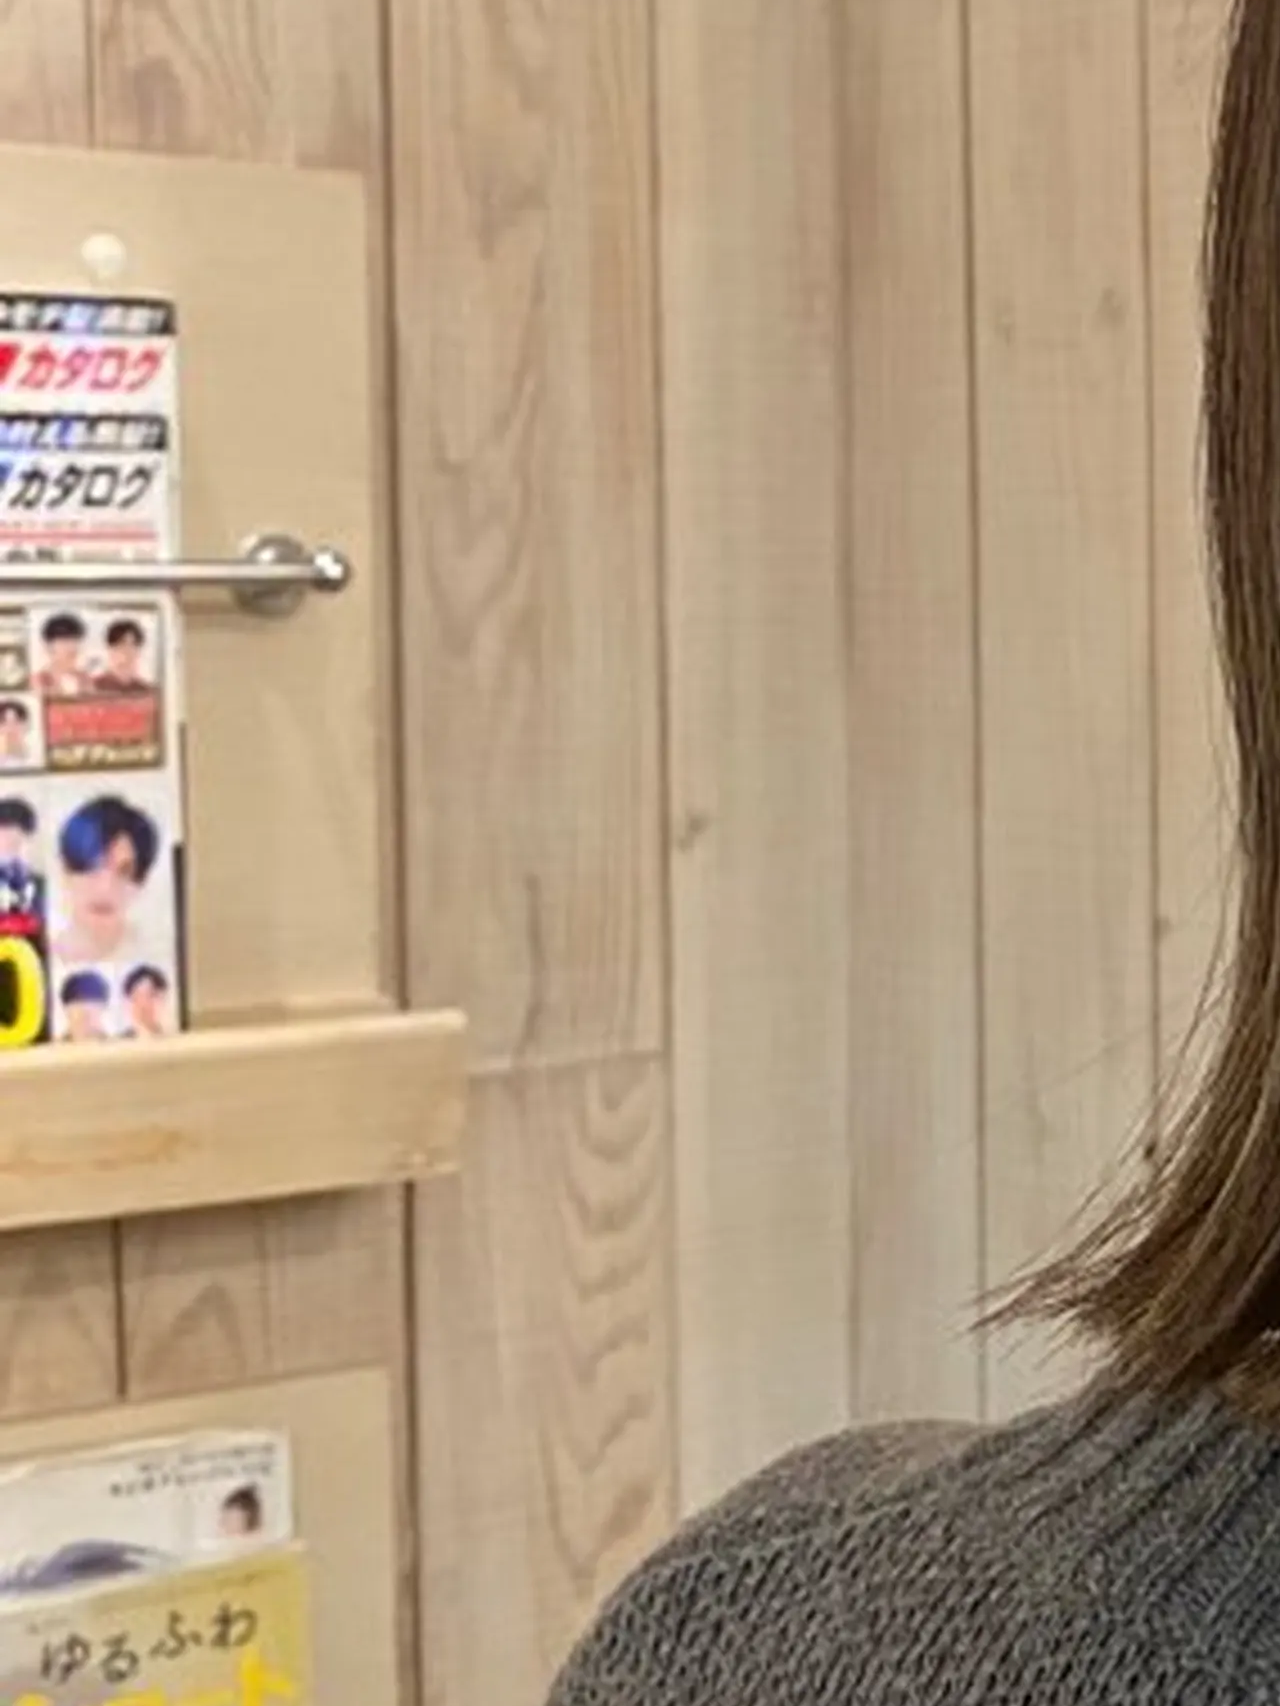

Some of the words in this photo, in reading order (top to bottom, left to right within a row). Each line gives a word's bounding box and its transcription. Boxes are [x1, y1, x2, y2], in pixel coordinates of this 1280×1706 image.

[8, 461, 158, 509] カタログ
[40, 1602, 258, 1684] ゆるふわ
